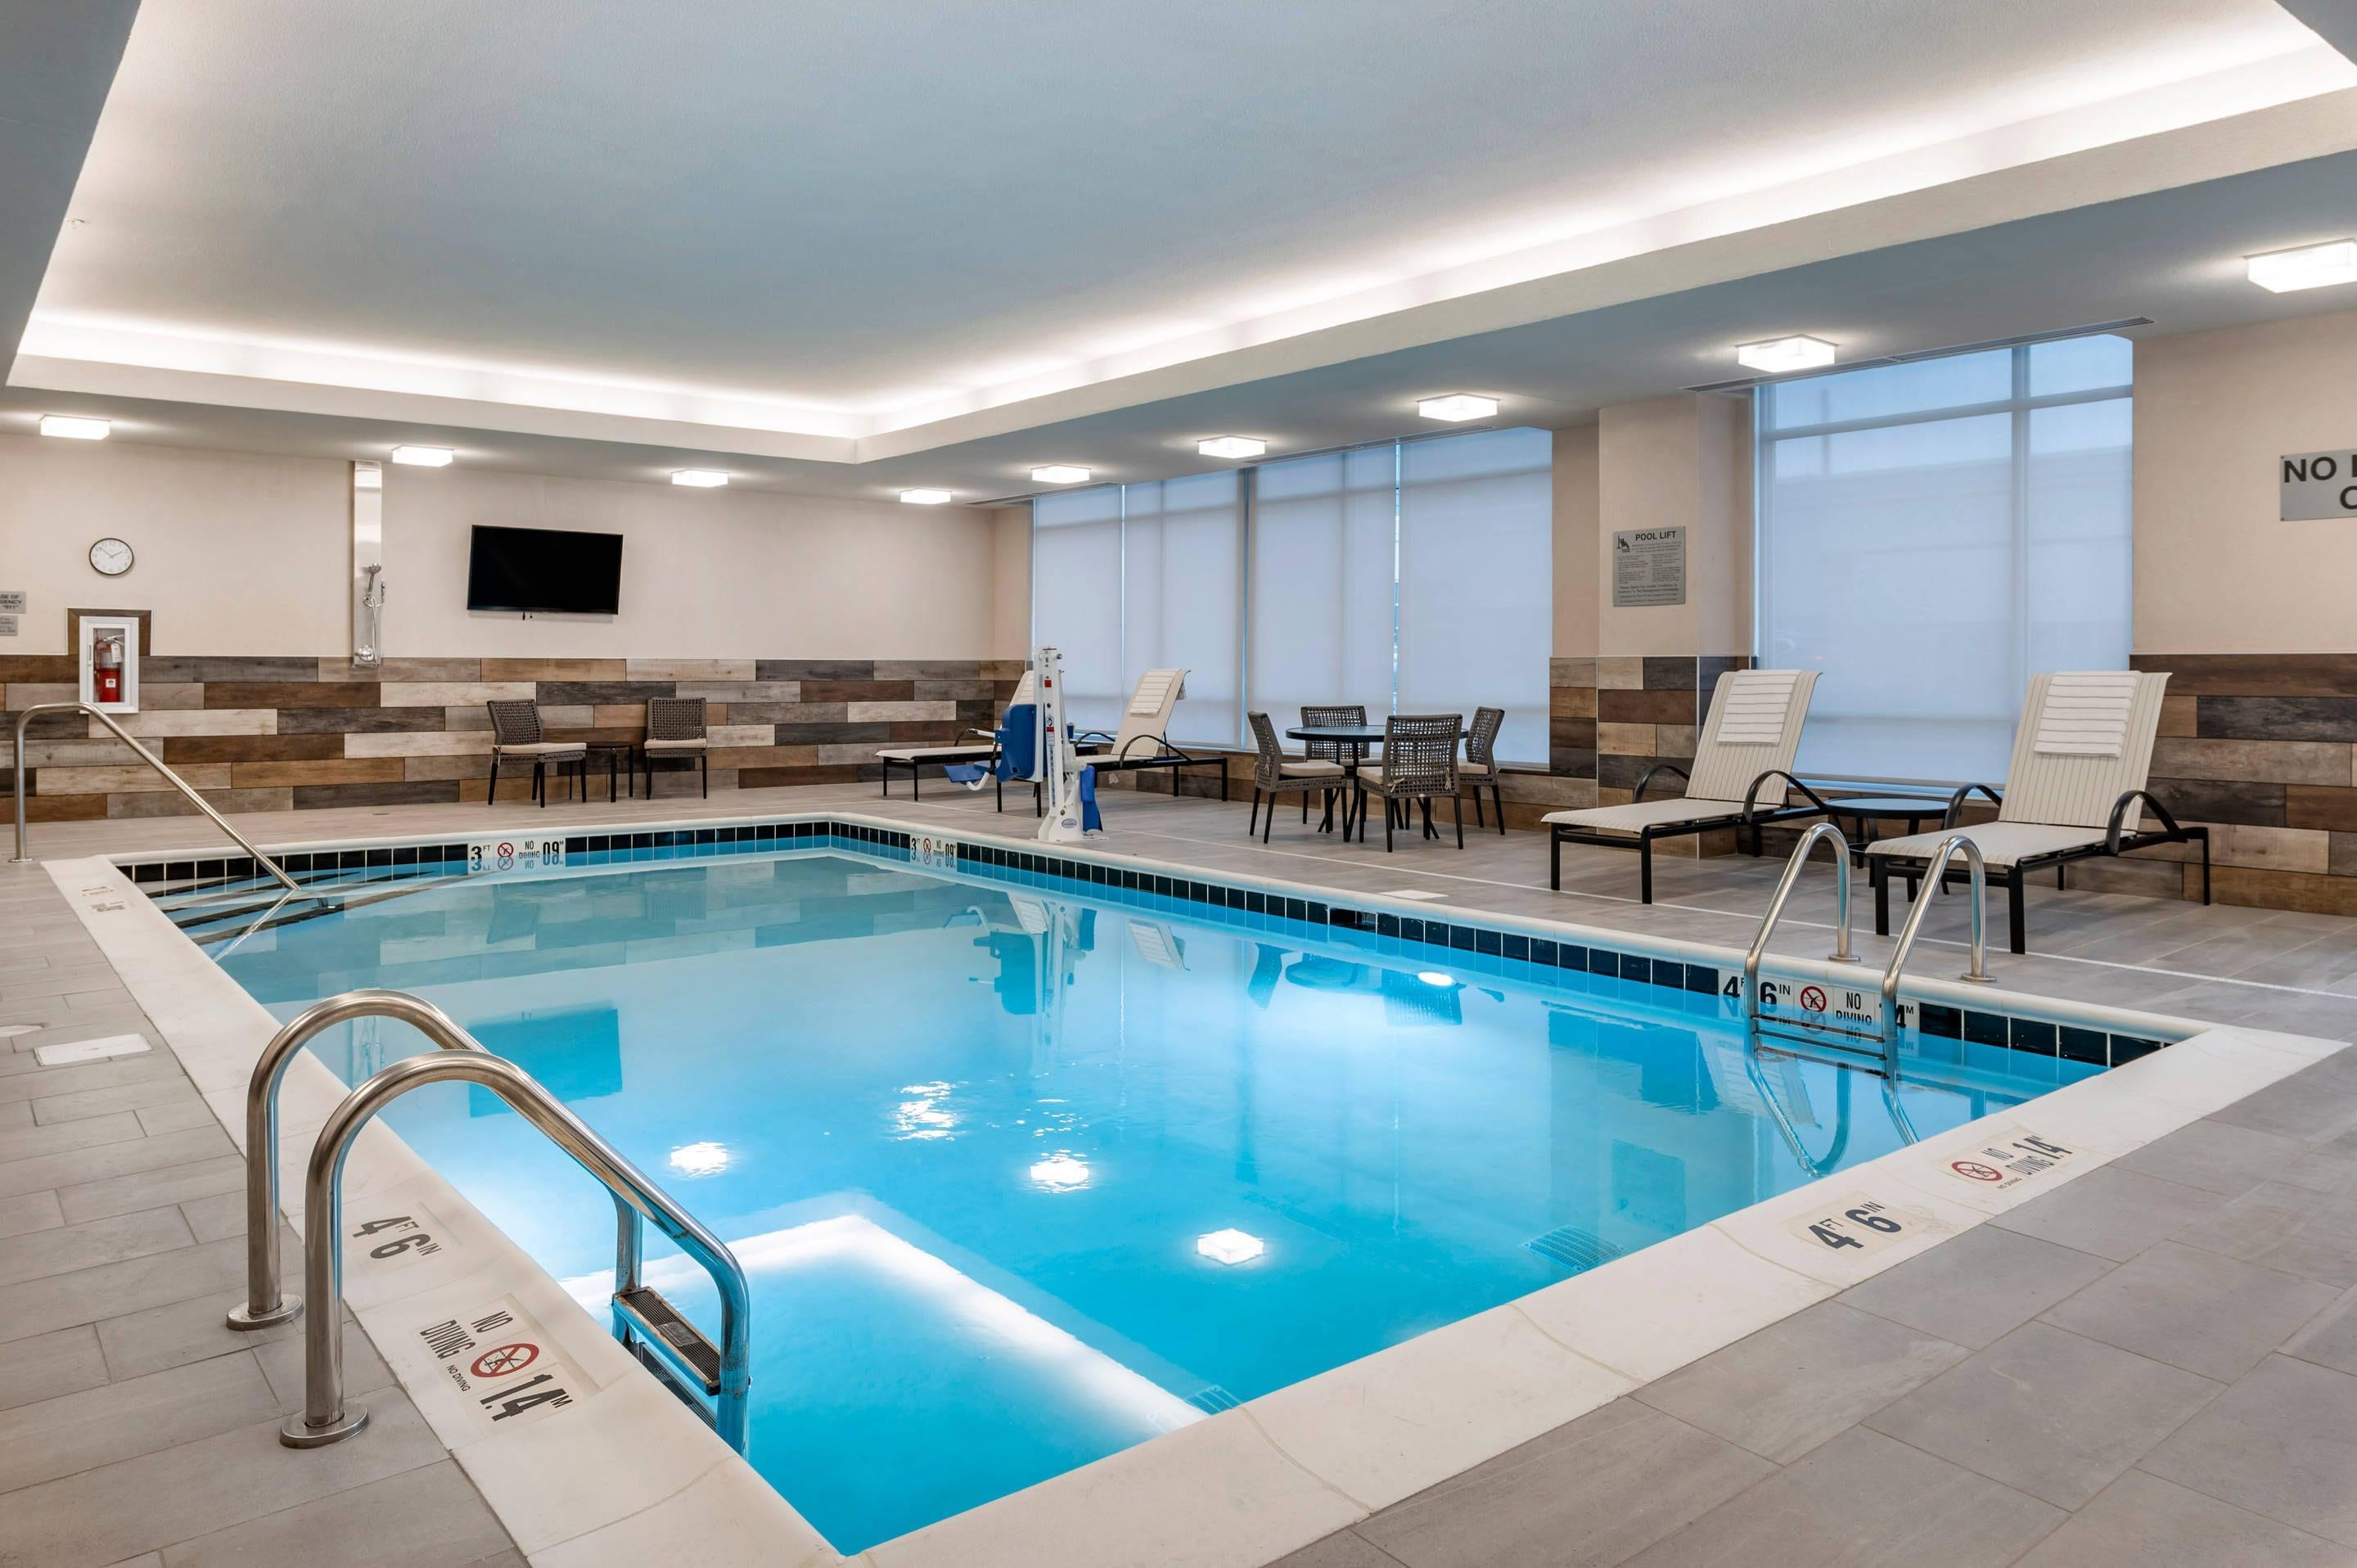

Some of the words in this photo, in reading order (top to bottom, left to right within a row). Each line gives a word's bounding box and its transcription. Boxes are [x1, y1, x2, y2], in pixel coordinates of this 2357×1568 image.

[2284, 457, 2337, 483] NO
[1635, 532, 1657, 541] POOL
[1660, 530, 1677, 539] LIFT
[525, 840, 534, 850] NO
[1723, 975, 1740, 998] 4
[1760, 981, 1778, 1006] 6
[1779, 984, 1791, 996] IN
[1845, 991, 1861, 1010] NO
[1905, 1006, 1914, 1015] M
[1981, 1147, 2014, 1161] NO
[2005, 1155, 2055, 1176] DIVING
[1859, 1201, 1886, 1213] IN
[352, 1216, 412, 1238] 4
[394, 1221, 420, 1232] FT
[1818, 1218, 1844, 1231] FT
[1845, 1209, 1902, 1233] 6
[370, 1233, 431, 1259] 6
[1808, 1224, 1865, 1249] 4
[416, 1243, 443, 1256] IN
[471, 1310, 514, 1334] NO
[420, 1319, 476, 1360] DIVING
[446, 1363, 458, 1374] NO
[452, 1372, 471, 1392] DIVING
[479, 1374, 567, 1422] 1.4
[550, 1395, 574, 1408] M
